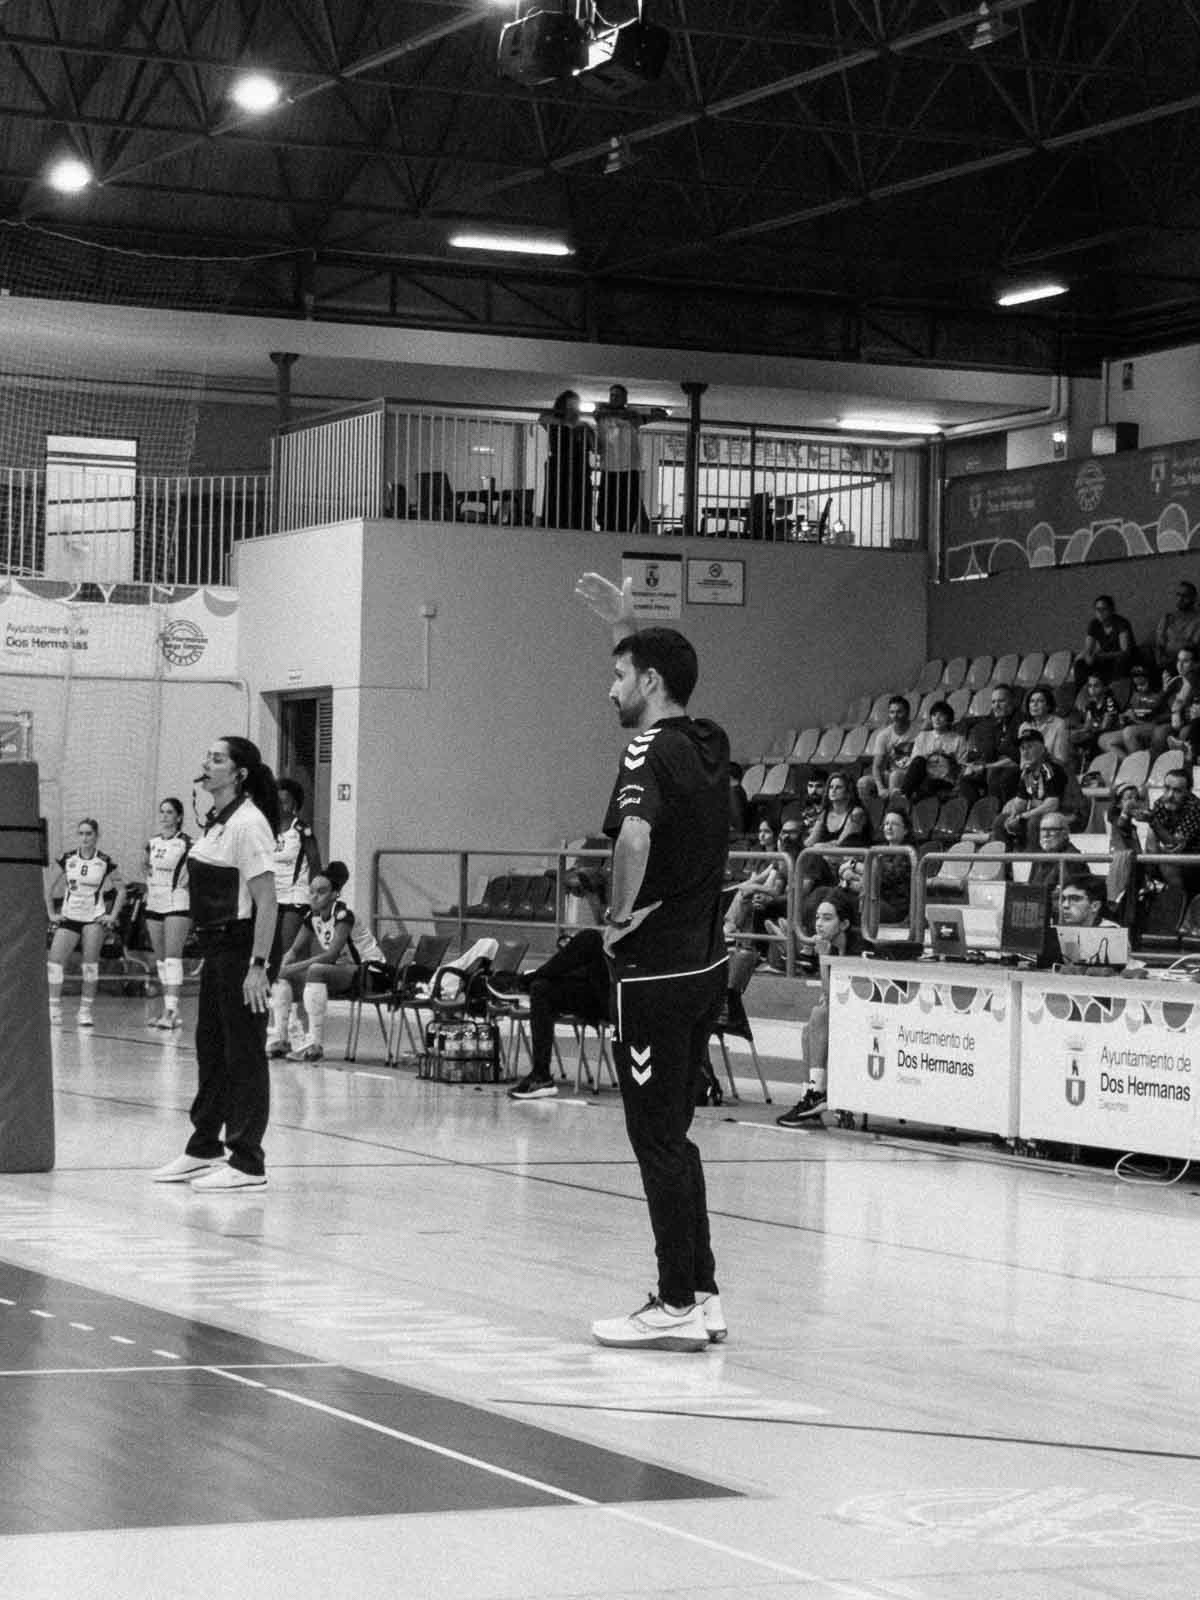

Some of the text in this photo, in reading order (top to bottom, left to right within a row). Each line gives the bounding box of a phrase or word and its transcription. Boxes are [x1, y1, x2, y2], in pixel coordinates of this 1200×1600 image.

[6, 636, 29, 648] Dos
[963, 1033, 975, 1050] de
[898, 1050, 974, 1077] Dos Hermanas
[1101, 1046, 1191, 1072] Ayuntamiento de
[1101, 1072, 1191, 1102] Dos Hermanas
